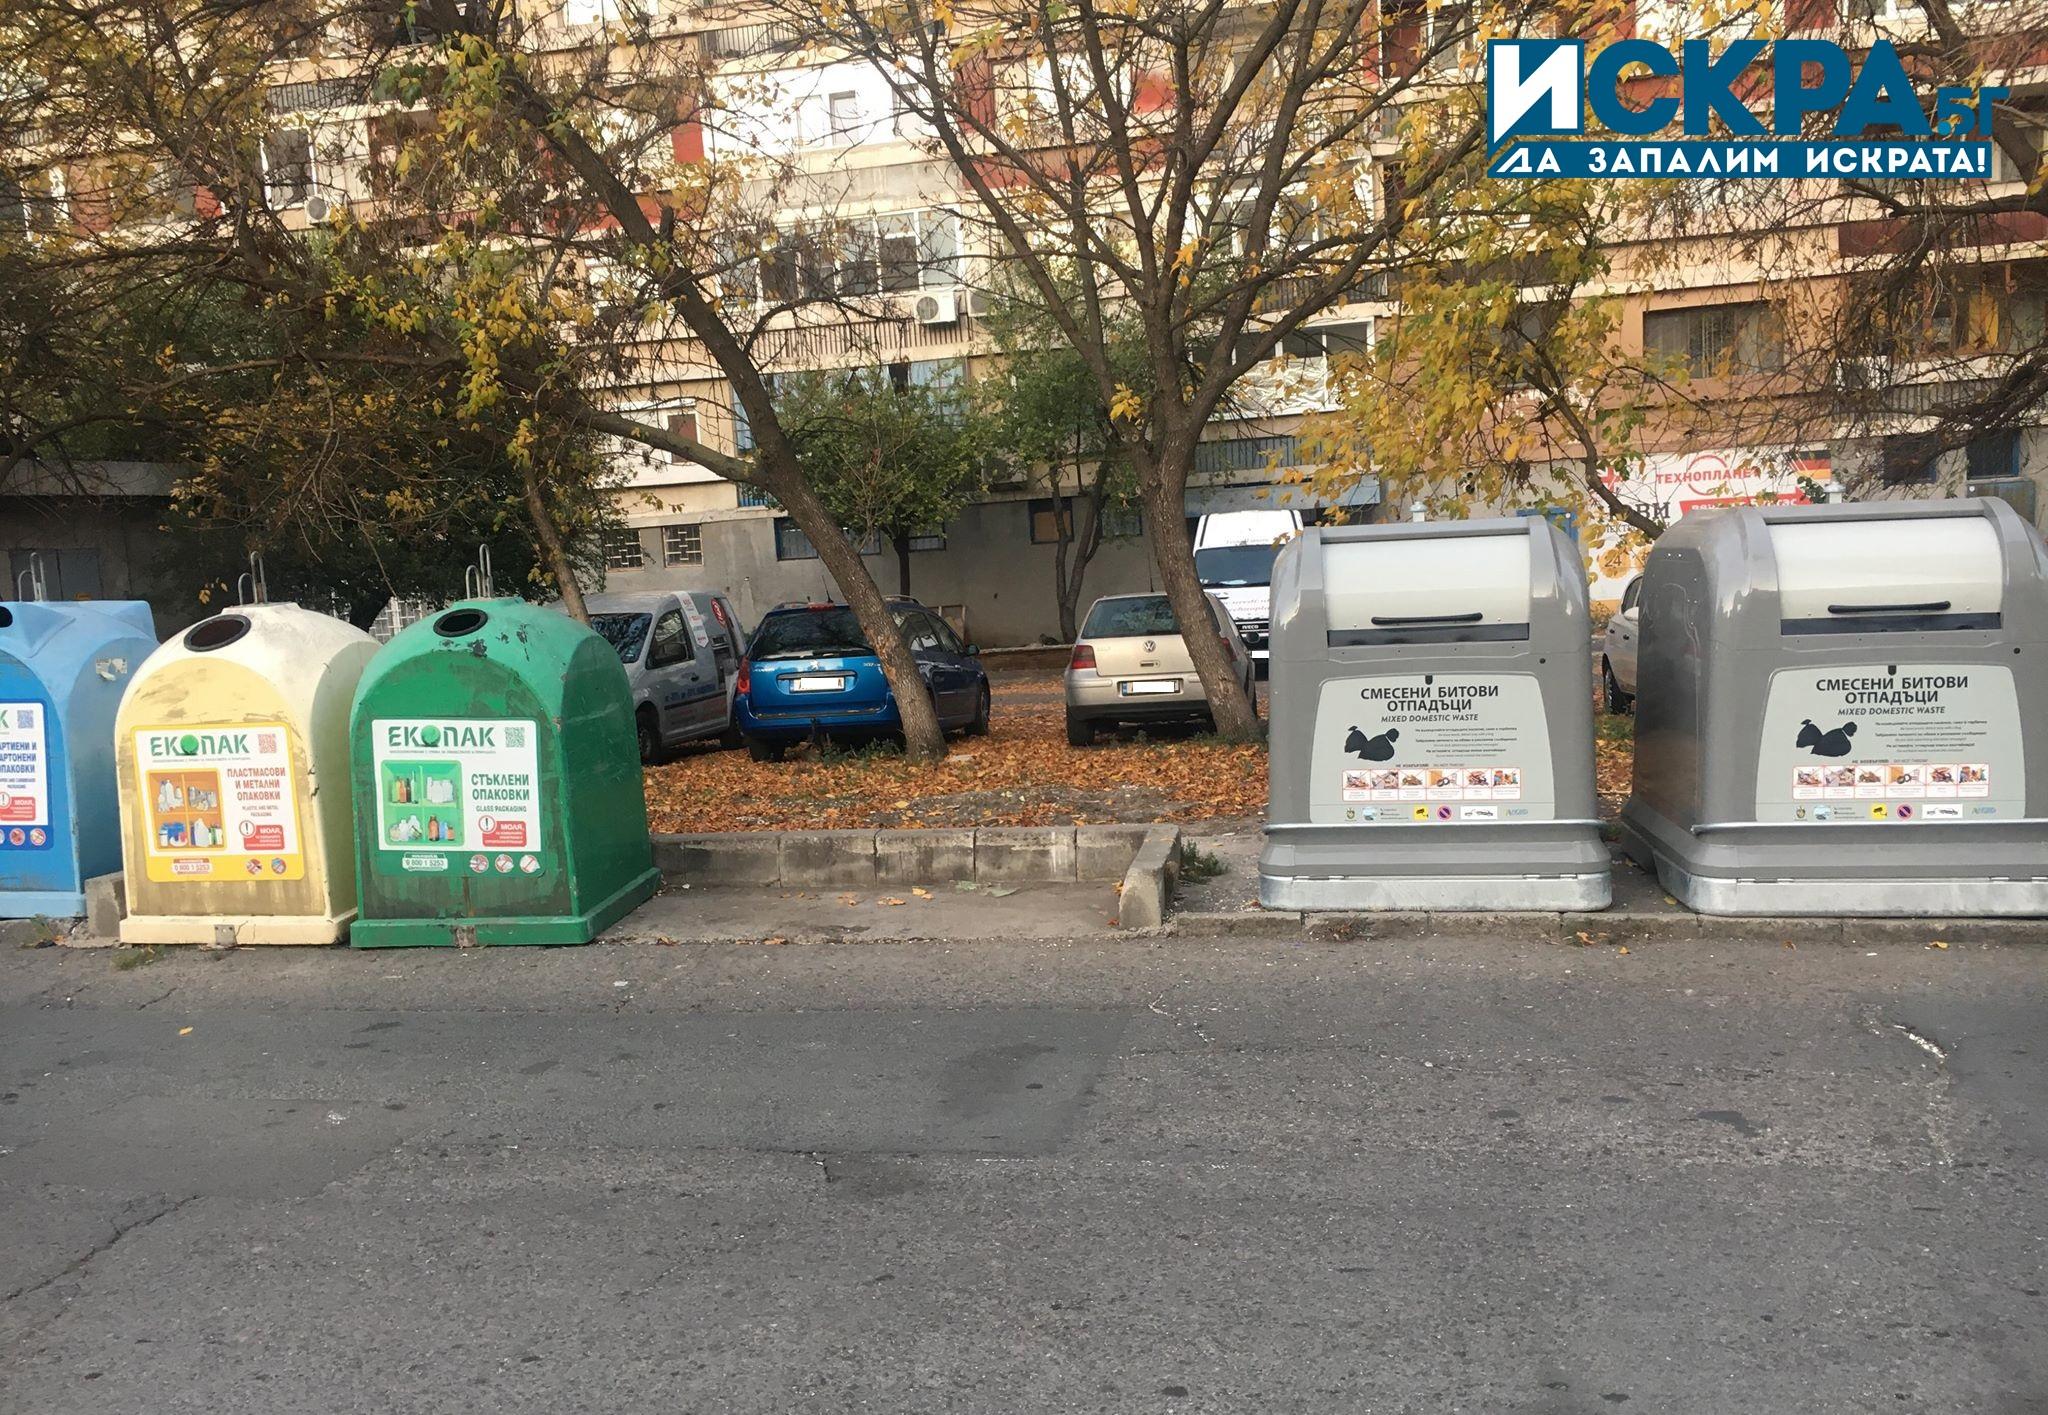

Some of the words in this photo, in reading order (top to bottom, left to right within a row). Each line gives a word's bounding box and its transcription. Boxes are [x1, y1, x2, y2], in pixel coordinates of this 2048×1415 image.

[1816, 678, 1893, 691] СМЕСЕНИ
[1901, 676, 1968, 689] БИТОВИ
[1360, 687, 1431, 700] СМЕСЕНИ
[1438, 685, 1498, 698] БИТОВИ
[1845, 691, 1938, 705] ОТПАДЪЦИ
[1387, 699, 1472, 713] ОТПАДЪЦИ
[1838, 707, 1866, 715] MIXED
[1869, 706, 1914, 715] DOMESTIC
[1917, 706, 1945, 714] WASTE
[1381, 715, 1407, 723] MIXED
[1409, 714, 1450, 722] DOMESTIC
[1452, 713, 1479, 721] WASTE
[388, 725, 495, 748] ЕКОПАК
[32, 742, 37, 750] И
[150, 734, 250, 756] ЕКОПАК
[227, 767, 286, 777] ПЛАСТМАСОВИ
[235, 781, 241, 789] И
[243, 779, 280, 788] МЕТАЛНИ
[471, 773, 529, 786] СТЪКЛЕНИ
[237, 791, 280, 801] ОПАКОВКИ
[472, 788, 529, 801] ОПАКОВКИ
